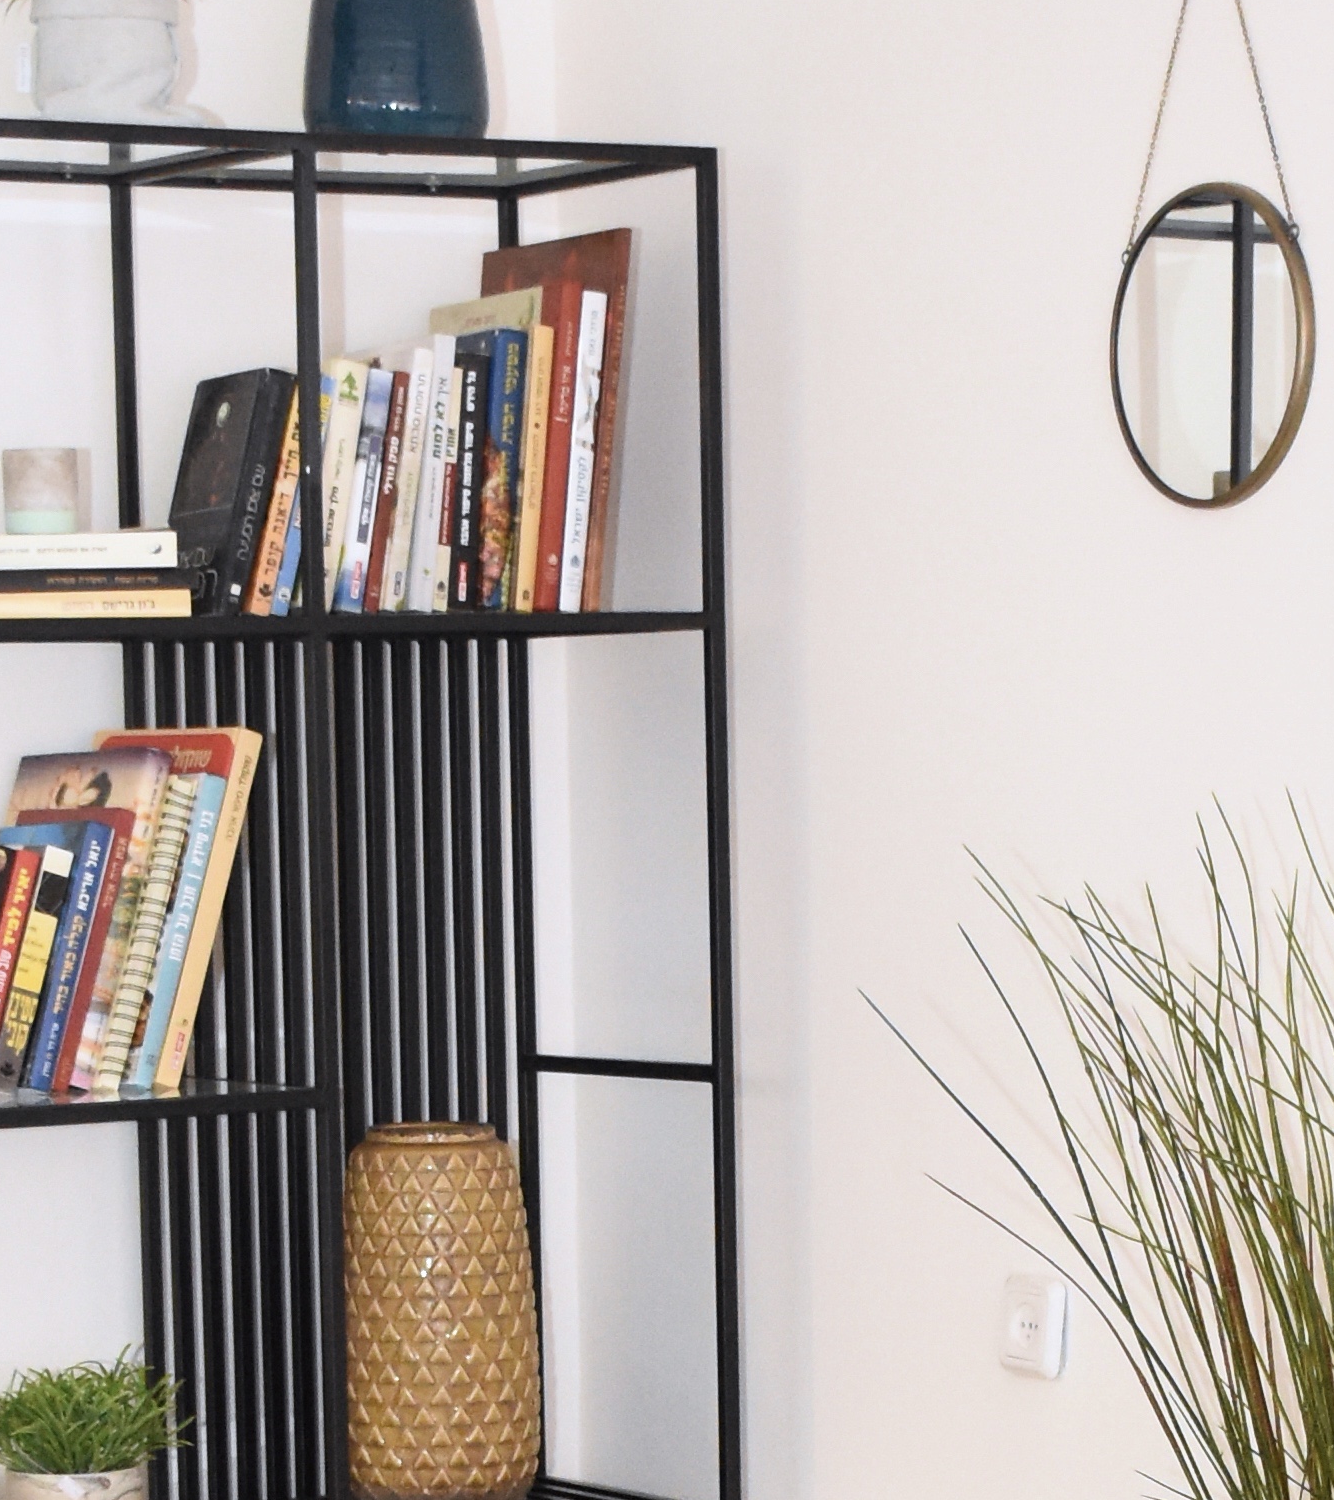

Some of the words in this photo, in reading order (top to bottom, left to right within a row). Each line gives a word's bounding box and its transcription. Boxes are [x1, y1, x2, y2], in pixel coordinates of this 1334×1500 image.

[434, 400, 445, 420] לא
[432, 425, 443, 459] למות
[14, 867, 30, 903] יאיר
[2, 906, 21, 946] לפיד
